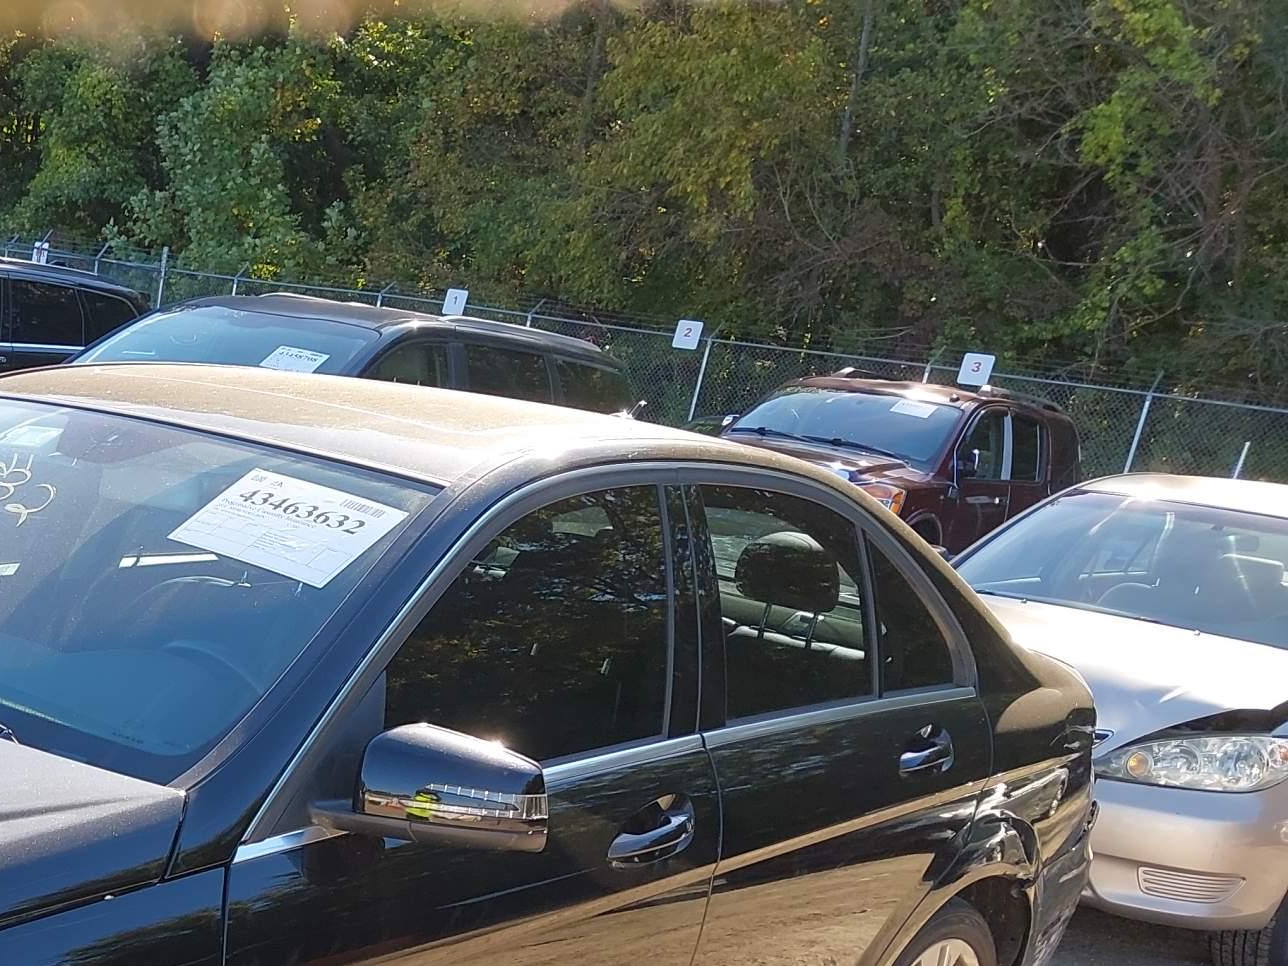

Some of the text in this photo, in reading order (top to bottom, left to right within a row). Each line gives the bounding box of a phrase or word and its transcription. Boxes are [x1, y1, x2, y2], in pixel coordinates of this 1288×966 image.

[684, 327, 693, 338] 2
[971, 361, 982, 373] 3
[239, 489, 366, 535] 43463632
